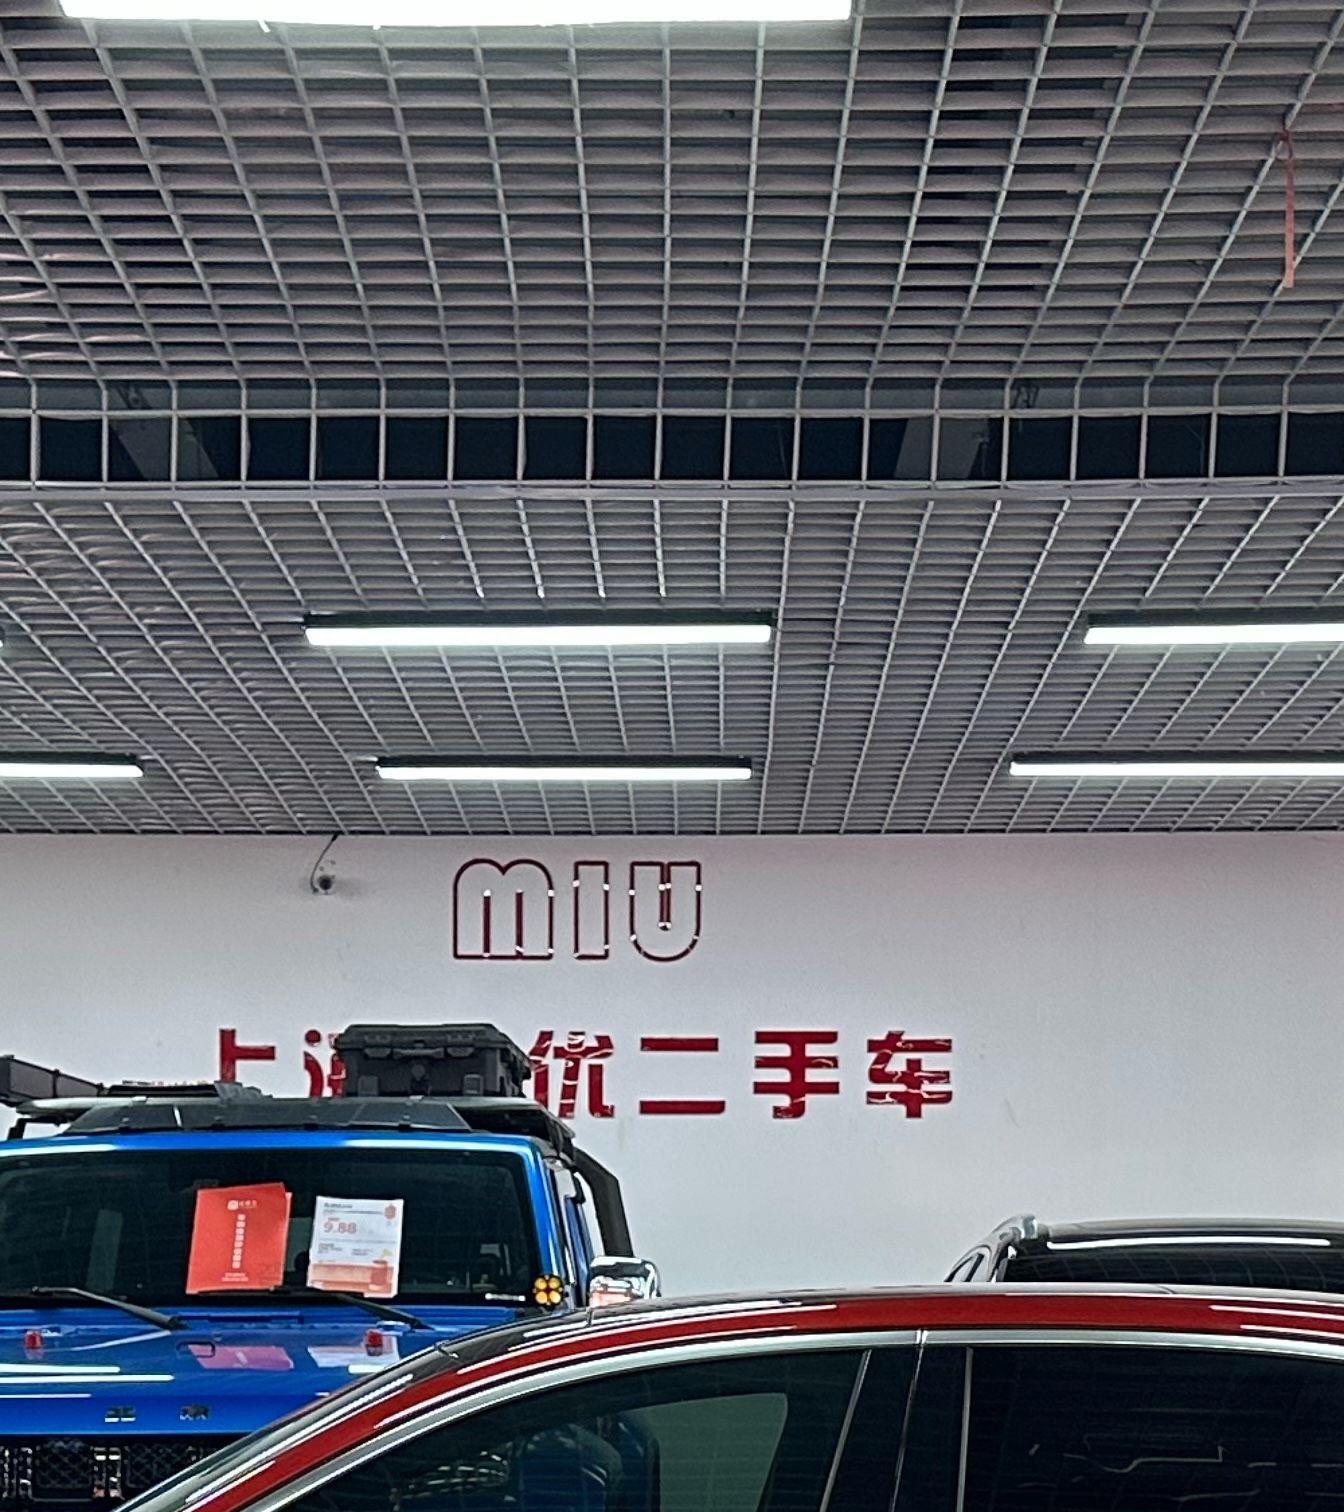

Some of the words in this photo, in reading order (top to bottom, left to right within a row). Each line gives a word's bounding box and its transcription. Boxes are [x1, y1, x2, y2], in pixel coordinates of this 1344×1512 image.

[453, 857, 703, 962] MIU
[219, 1028, 954, 1119] 上优二手车
